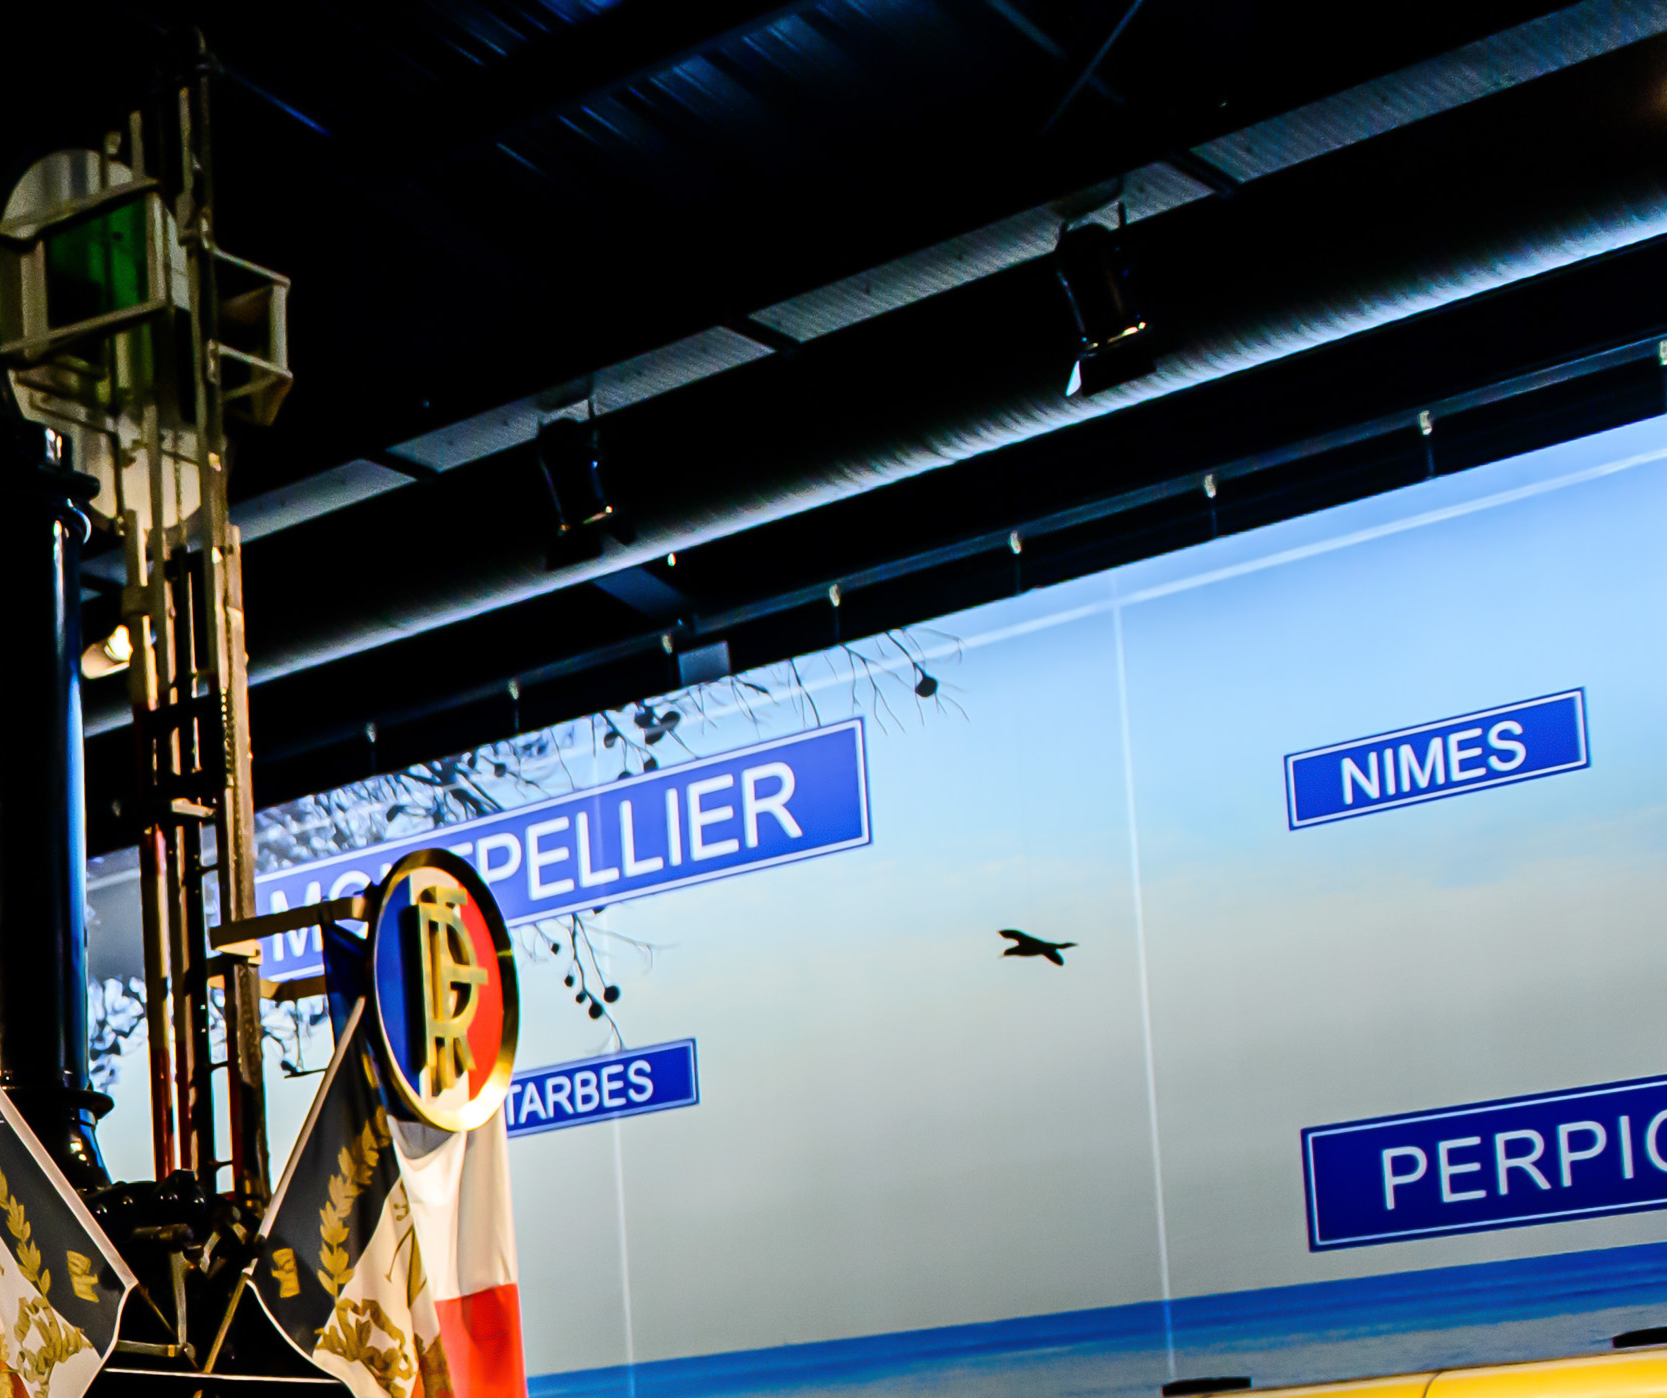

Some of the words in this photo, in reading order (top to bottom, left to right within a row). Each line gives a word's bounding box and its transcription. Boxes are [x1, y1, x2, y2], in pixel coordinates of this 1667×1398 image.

[1340, 720, 1527, 805] NIMES
[269, 761, 803, 963] MOPELLIER
[506, 1059, 654, 1126] TARBES
